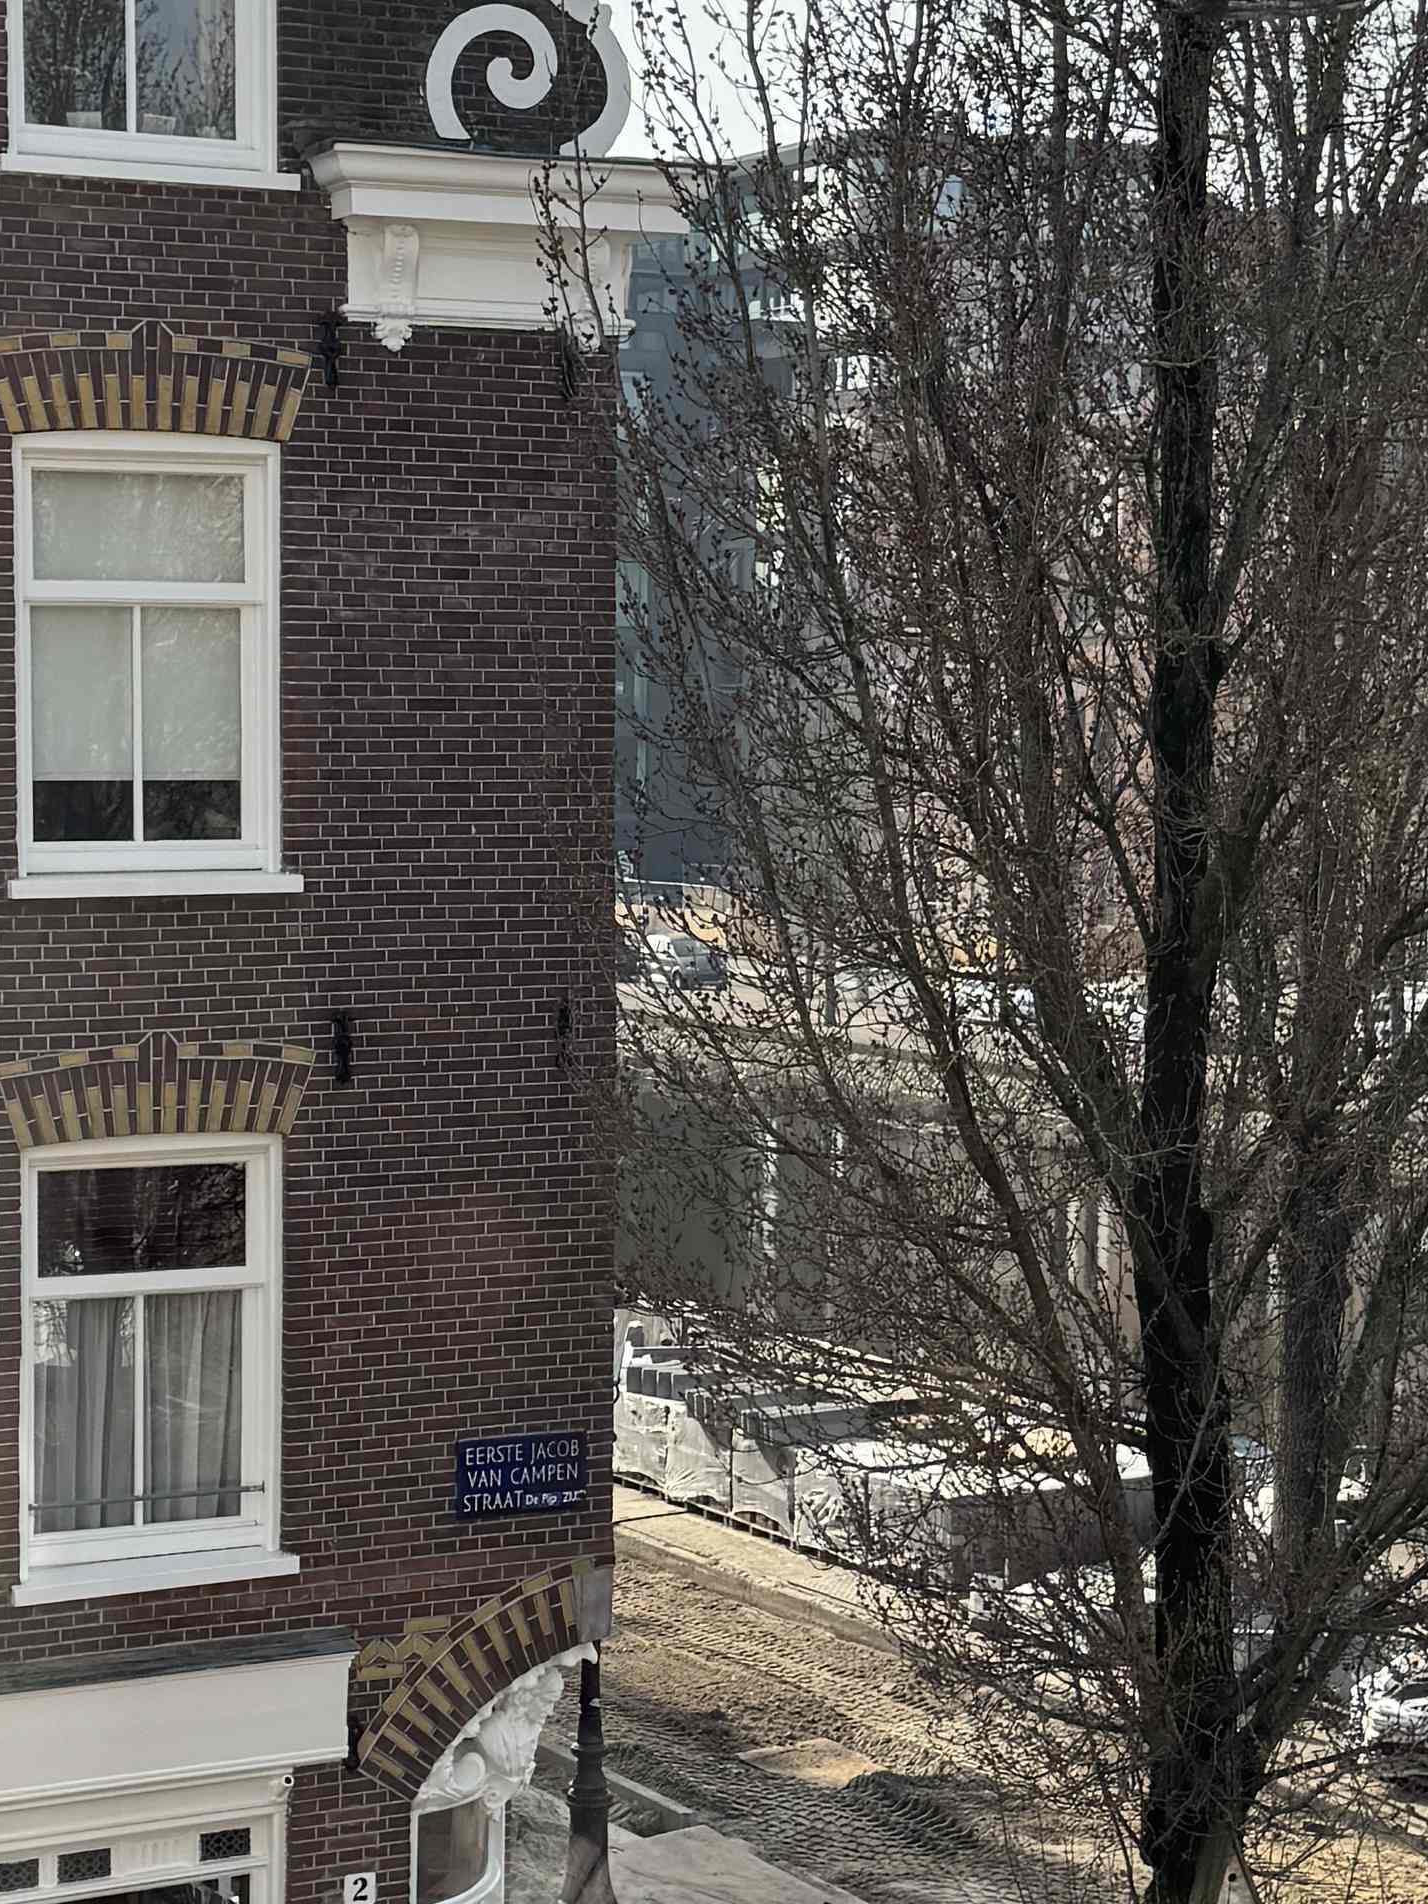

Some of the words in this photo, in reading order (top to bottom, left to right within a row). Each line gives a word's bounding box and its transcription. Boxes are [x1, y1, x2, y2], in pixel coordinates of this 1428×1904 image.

[465, 1443, 524, 1466] EERSTE
[530, 1439, 580, 1464] JACOB
[468, 1469, 502, 1489] VAN
[510, 1462, 579, 1485] CAMPEN
[463, 1490, 524, 1513] STRAAT
[352, 1877, 369, 1902] 2
